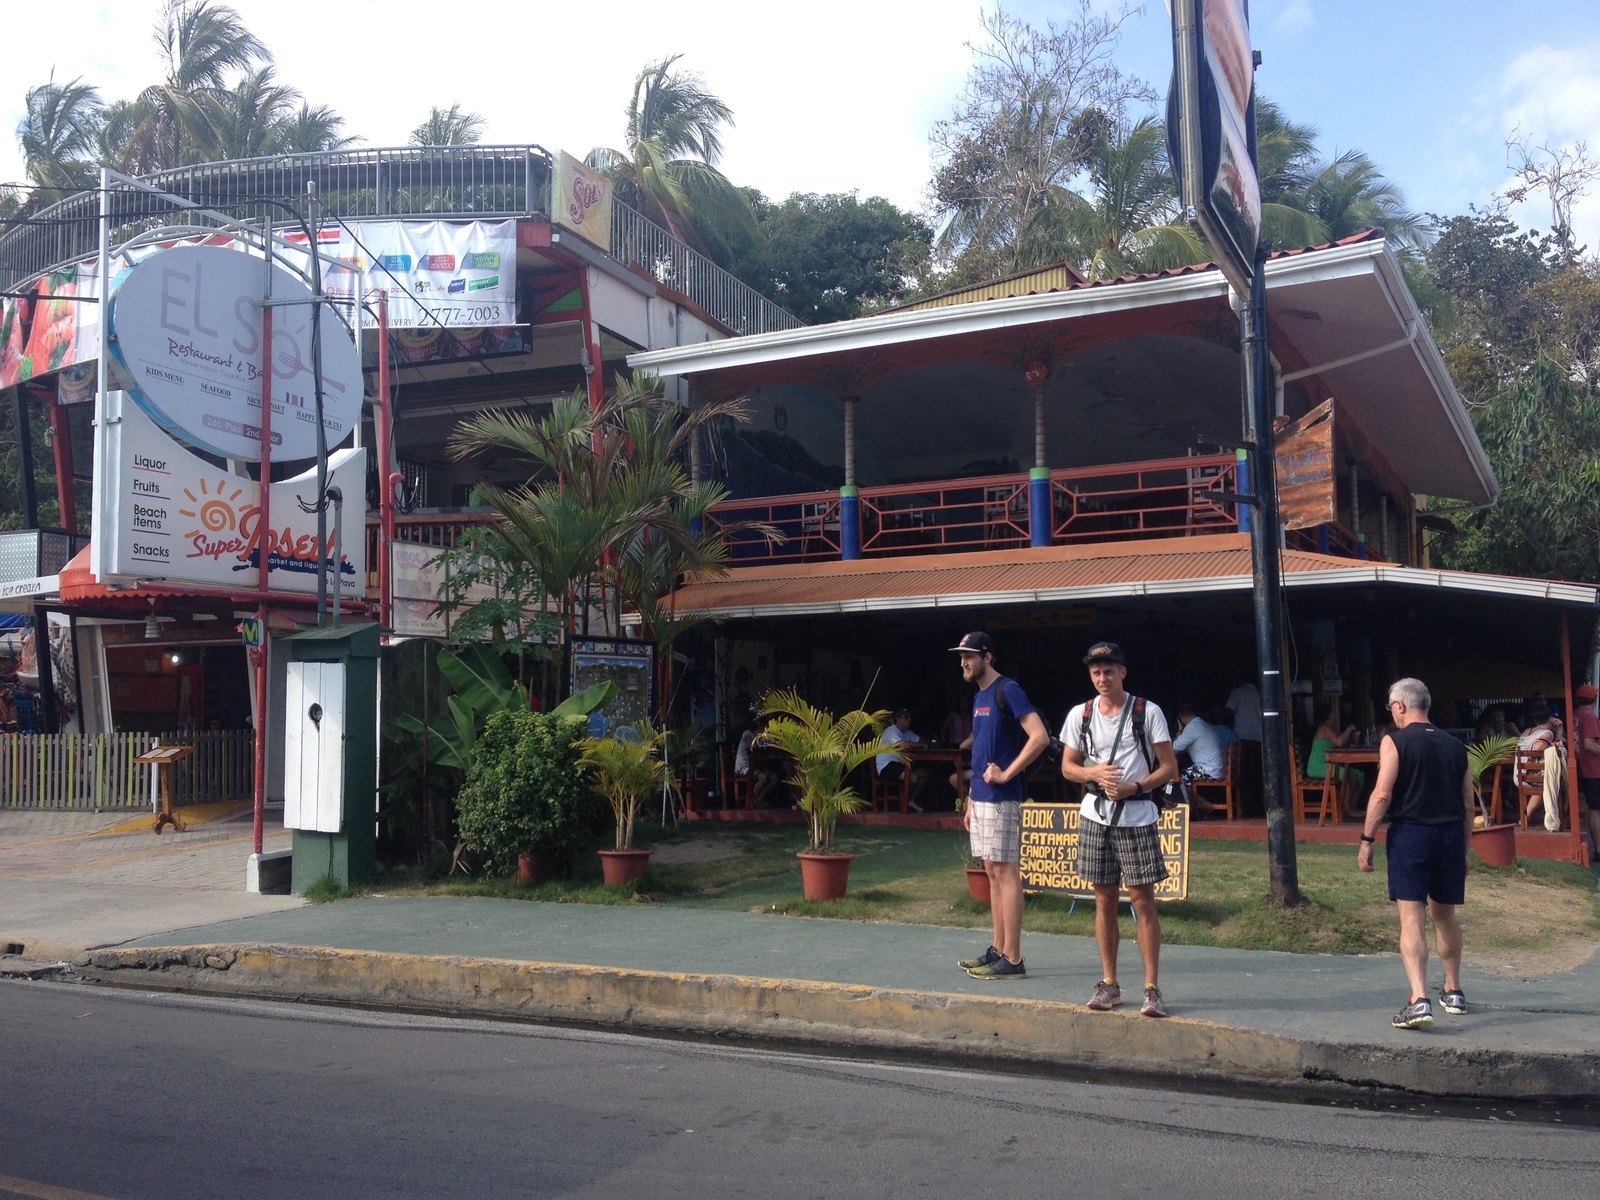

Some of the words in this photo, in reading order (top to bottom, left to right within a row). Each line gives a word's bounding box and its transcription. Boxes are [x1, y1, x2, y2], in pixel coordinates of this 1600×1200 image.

[418, 306, 500, 326] 2777-7003
[168, 337, 233, 370] Restaurant
[246, 361, 264, 380] Ba
[145, 366, 163, 378] KIDS
[164, 370, 184, 384] MENU
[200, 382, 232, 397] SEAFOOD
[247, 395, 262, 407] NICE
[296, 410, 316, 421] HAPPY
[134, 455, 166, 470] Liquor
[133, 479, 160, 493] Fruits
[134, 504, 167, 519] Beach
[133, 515, 162, 529] items
[133, 543, 170, 558] Snacks
[186, 534, 247, 560] Super
[268, 557, 288, 566] arket
[289, 560, 303, 568] and
[304, 561, 319, 570] liqu
[2, 585, 14, 597] ice
[15, 582, 41, 595] cream
[1022, 809, 1054, 829] BOOK
[1156, 810, 1182, 830] ERE
[1021, 832, 1080, 846] CATAMAR
[1020, 845, 1056, 860] CANOPY
